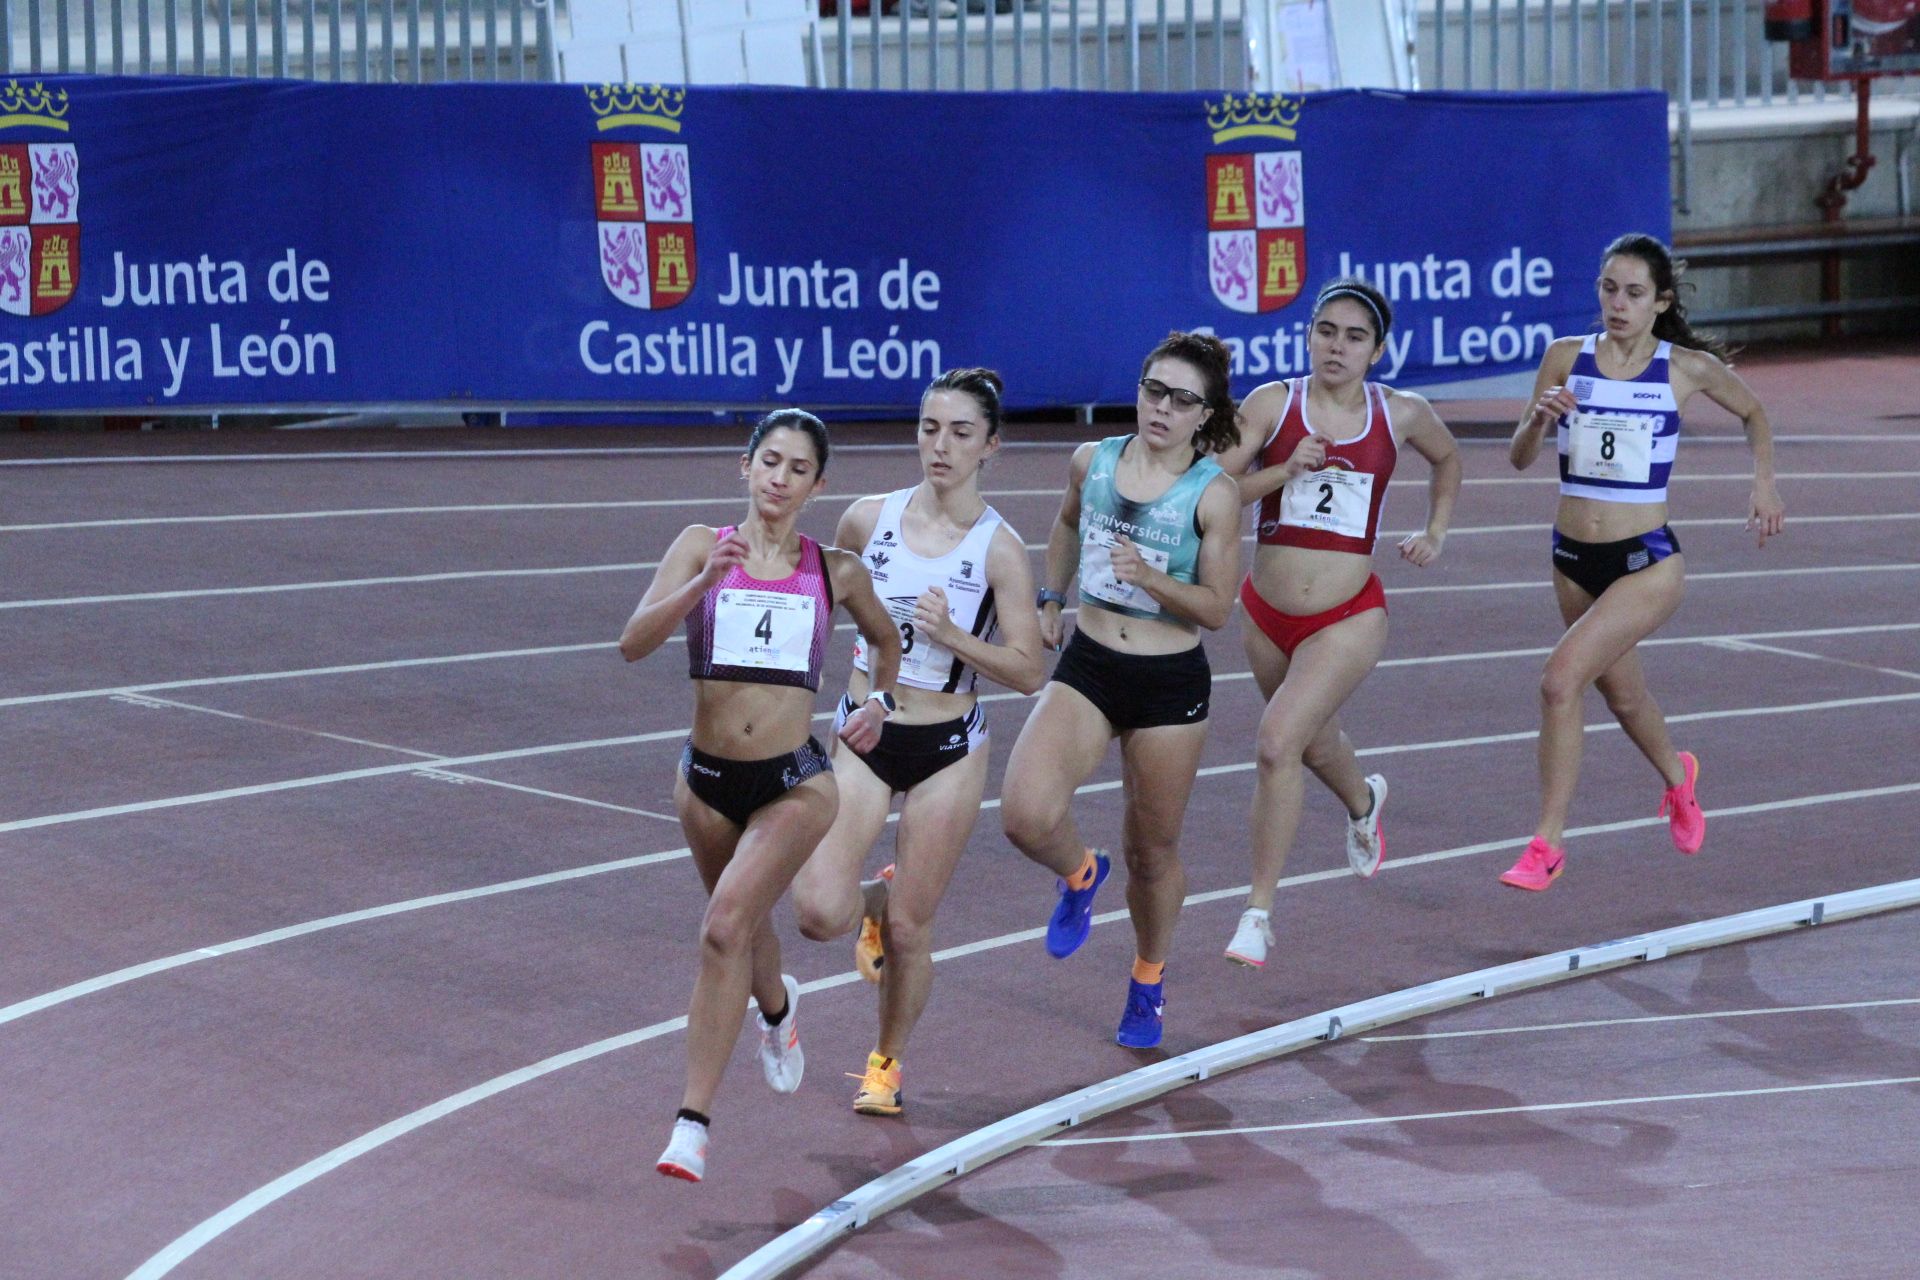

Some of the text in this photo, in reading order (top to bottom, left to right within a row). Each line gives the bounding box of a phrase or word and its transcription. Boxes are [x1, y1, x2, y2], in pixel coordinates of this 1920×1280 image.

[102, 249, 329, 306] Junta de
[719, 253, 939, 309] Junta de
[1492, 248, 1554, 297] de
[0, 320, 335, 396] astilla y León
[580, 321, 940, 393] Castilla y León
[1386, 331, 1412, 379] y
[1434, 312, 1554, 364] León
[1601, 431, 1615, 460] 8
[1315, 483, 1333, 514] 2
[873, 540, 898, 548] VIATOR
[1093, 512, 1181, 546] universidad
[754, 609, 772, 645] 4
[900, 622, 914, 654] 3
[939, 741, 969, 751] VIATOR
